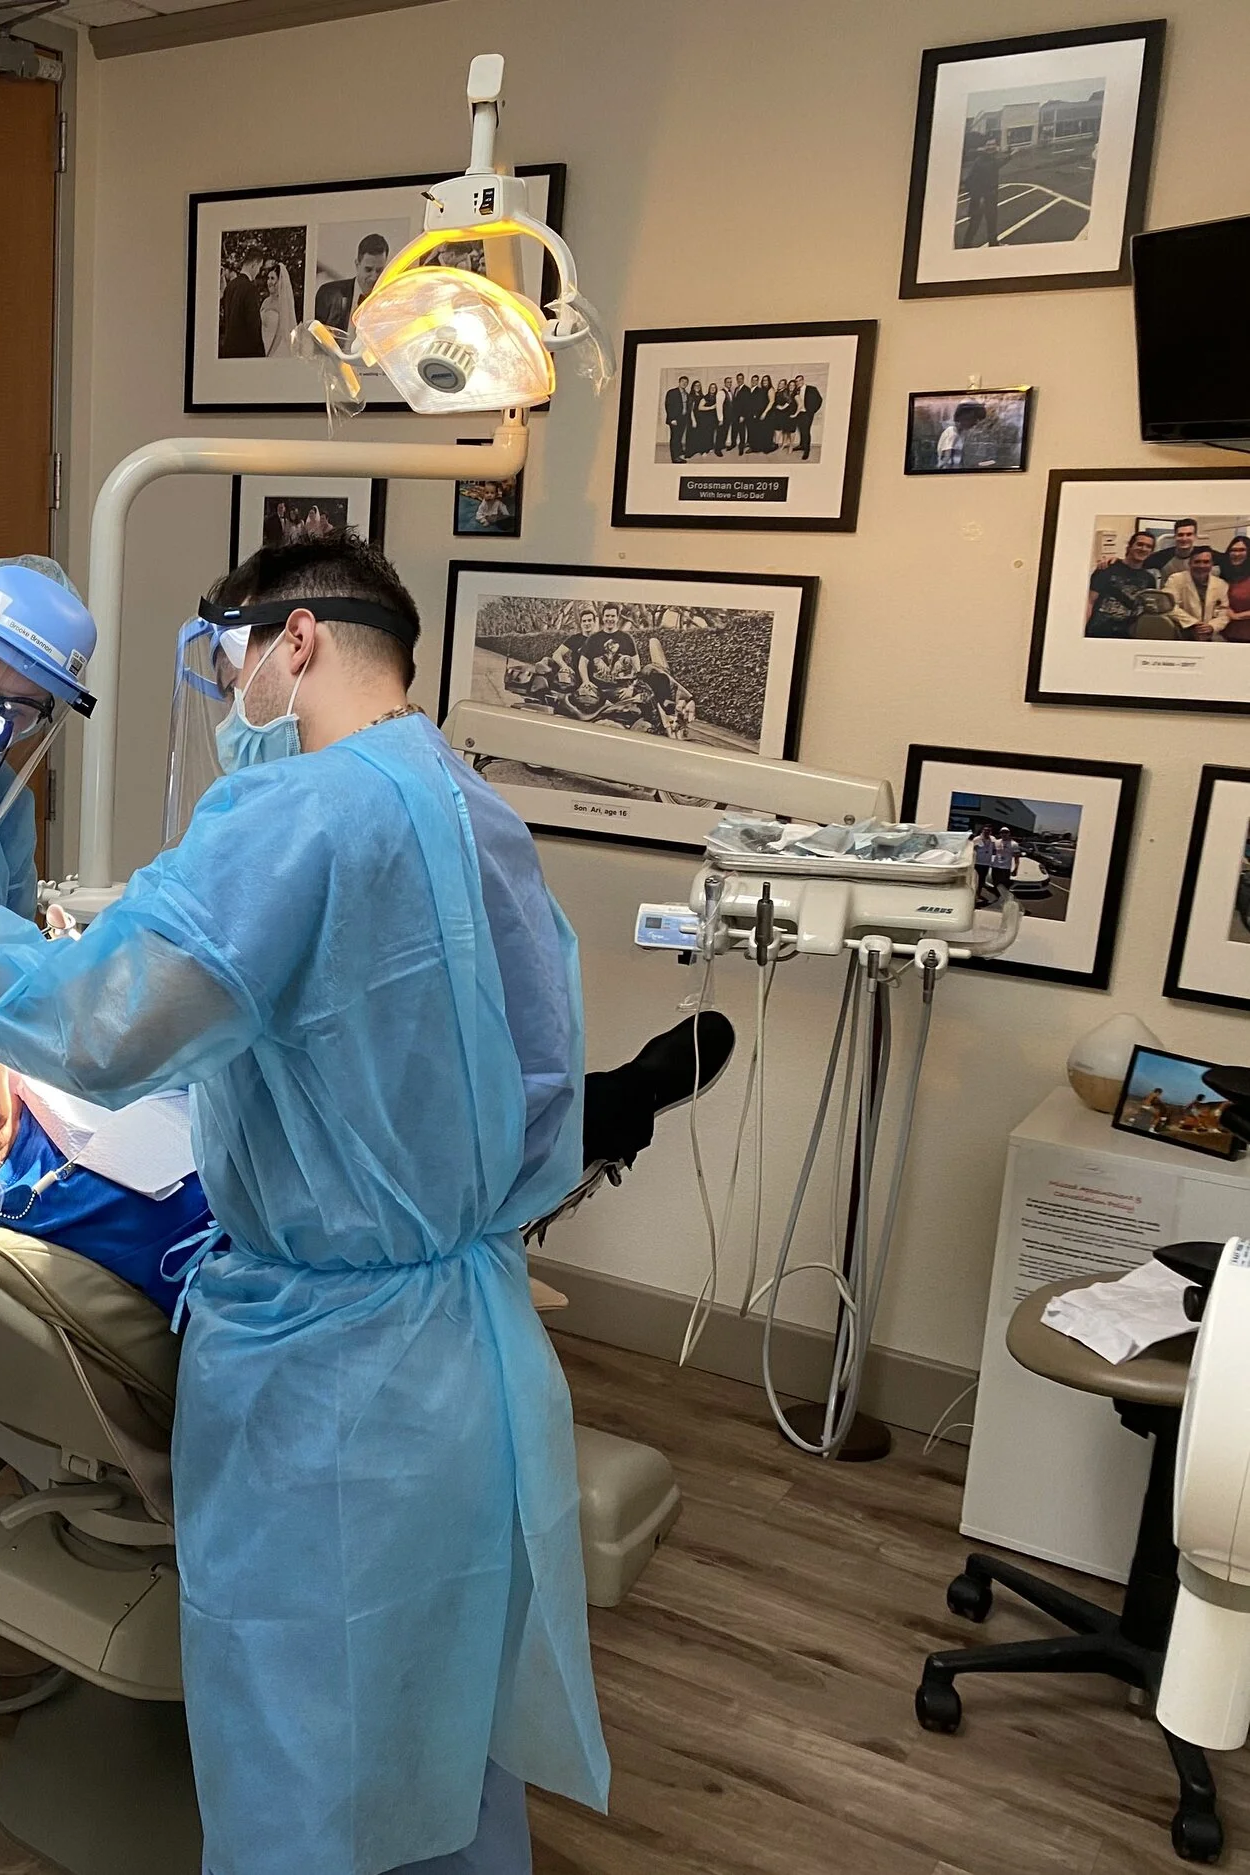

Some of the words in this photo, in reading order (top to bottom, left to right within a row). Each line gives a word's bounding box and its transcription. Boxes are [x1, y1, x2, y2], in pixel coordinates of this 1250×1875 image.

[687, 481, 731, 490] Grossman
[733, 481, 754, 490] Clan
[756, 482, 779, 490] 2019
[9, 621, 30, 637] Brooke
[30, 634, 53, 653] Brannon
[590, 806, 602, 815] Ari,
